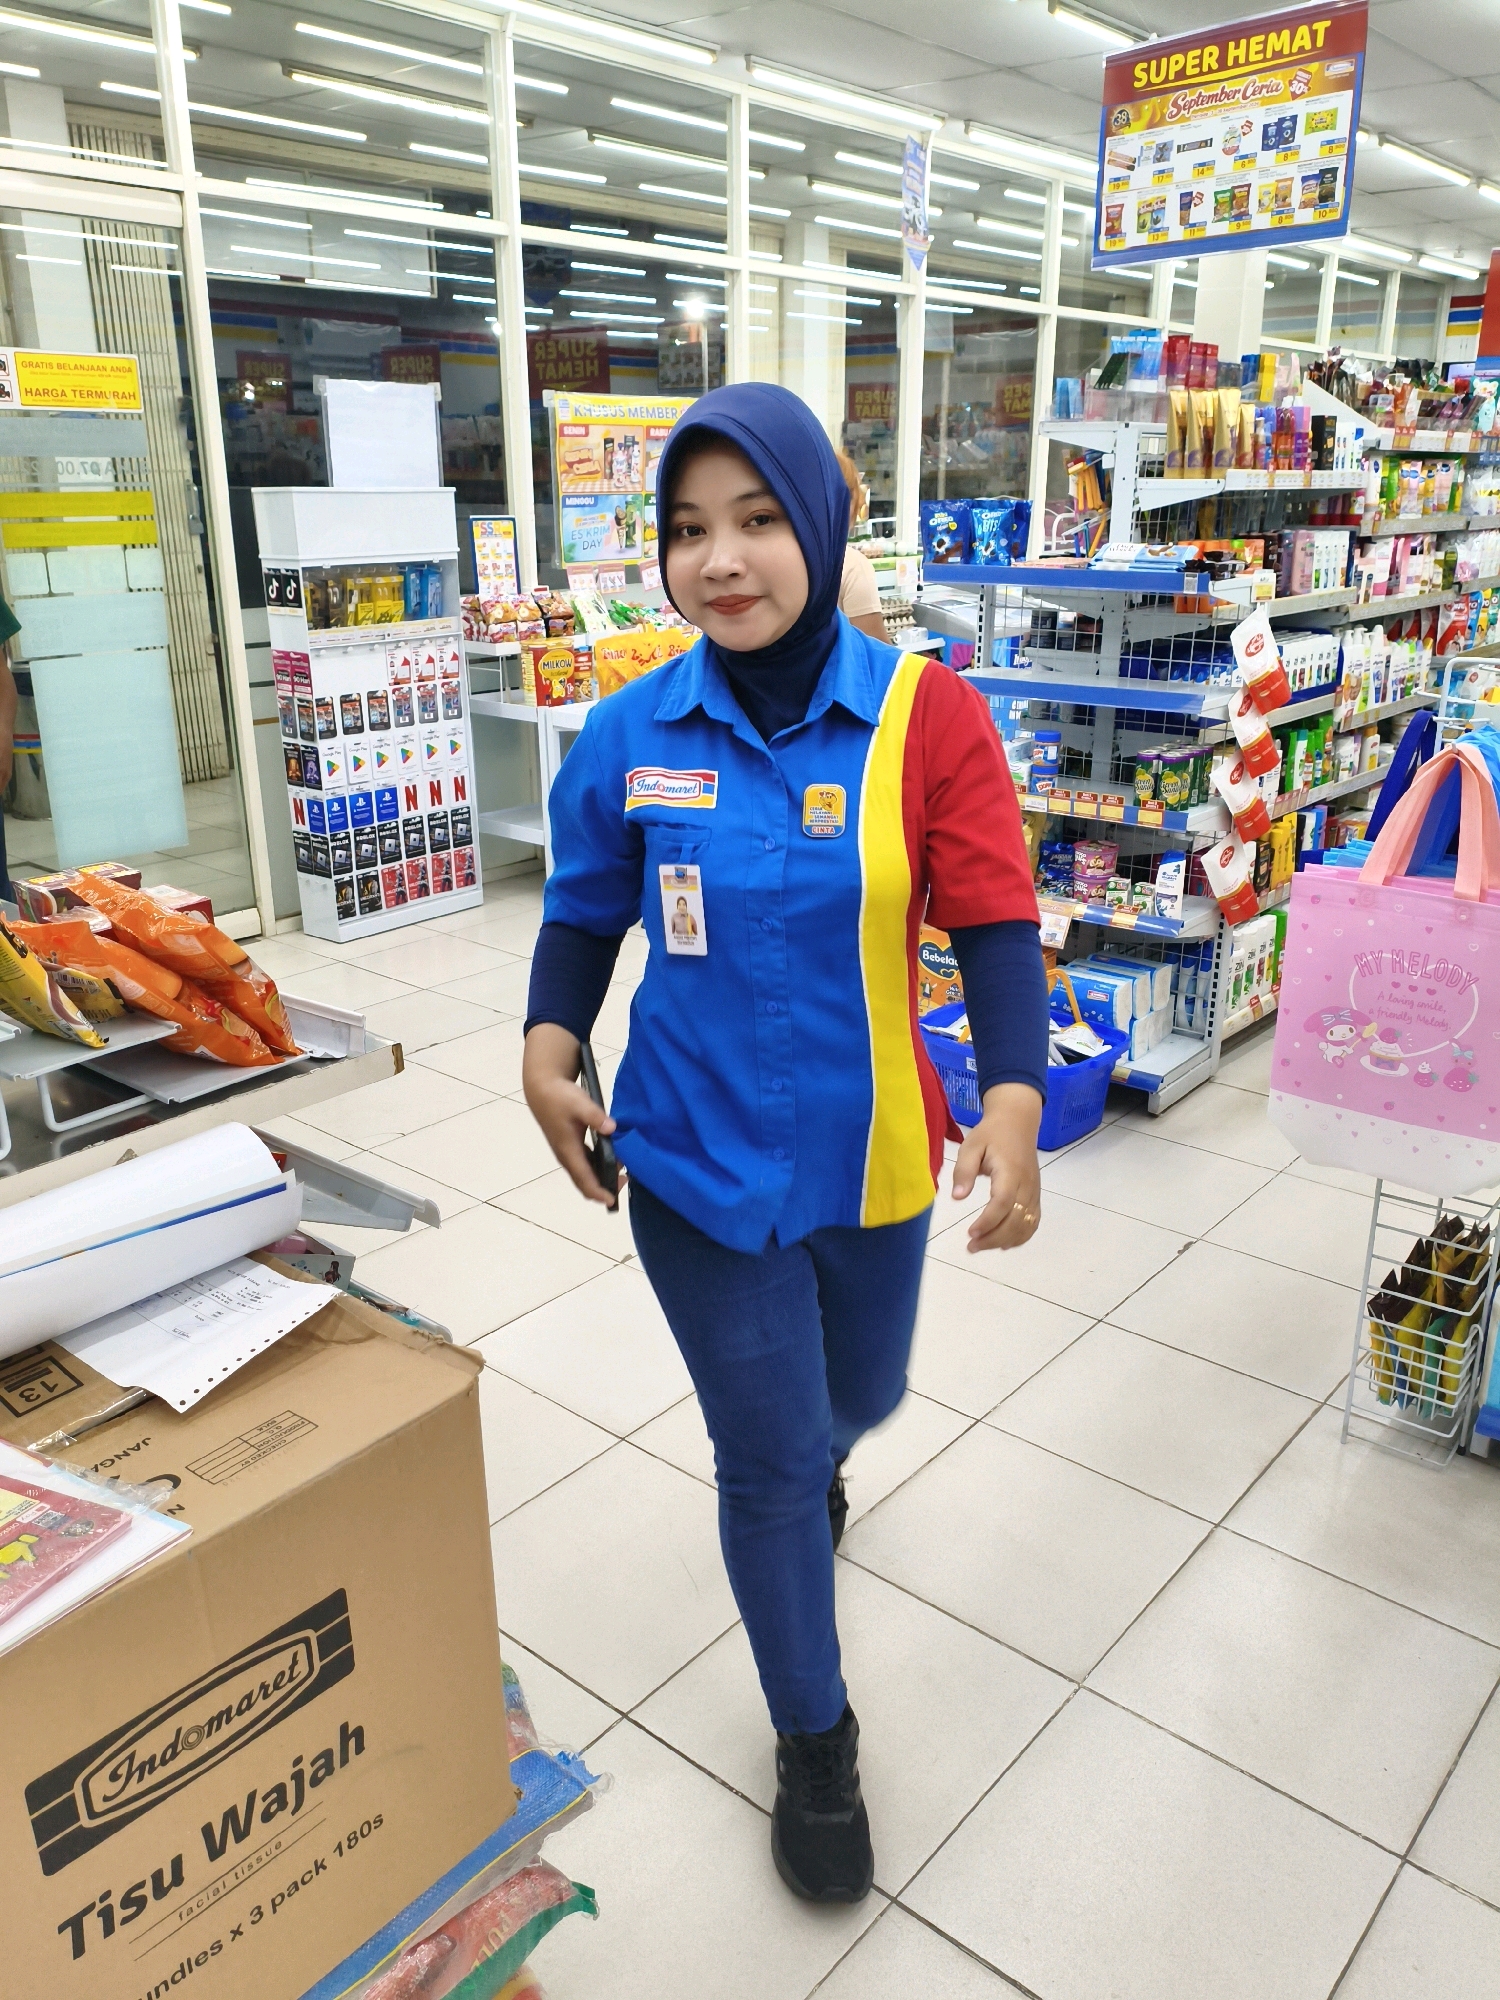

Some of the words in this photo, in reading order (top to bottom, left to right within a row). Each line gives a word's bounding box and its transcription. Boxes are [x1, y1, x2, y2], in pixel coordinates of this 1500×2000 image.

[1133, 44, 1219, 88] SUPER
[1227, 20, 1332, 67] HEMAT
[1166, 87, 1241, 121] September
[1241, 78, 1282, 102] Ceria
[21, 360, 54, 370] GRATIS
[56, 362, 108, 372] BELANJAAN
[110, 363, 132, 374] ANDA
[24, 387, 68, 398] HARGA
[71, 389, 137, 401] TERMURAH
[574, 404, 625, 418] KHUSUS
[628, 406, 678, 419] MEMBER
[563, 425, 586, 436] SENIN
[565, 496, 595, 506] MINGGU
[582, 538, 604, 551] DAY
[542, 658, 574, 671] MILKOW
[634, 778, 699, 795] Indomaret
[811, 826, 835, 834] CINTA
[1353, 949, 1384, 978] MY
[1391, 949, 1480, 995] MELODY
[1377, 990, 1385, 1001] A
[1388, 992, 1415, 1010] loving
[1416, 999, 1447, 1014] smile,
[1377, 1006, 1413, 1025] friendly
[1416, 1013, 1452, 1032] Melody.
[18, 1380, 59, 1403] 13
[257, 1420, 306, 1449] PRODUCTION
[250, 1439, 287, 1461] CHECKED
[102, 1649, 303, 1803] Indomaret
[57, 1852, 186, 1962] Tisu
[200, 1720, 367, 1864] Wajah
[178, 1879, 228, 1922] facial
[233, 1839, 284, 1881] tissue
[229, 1922, 245, 1943] x
[249, 1904, 265, 1927] 3
[270, 1857, 328, 1915] pack
[333, 1812, 385, 1860] 180s
